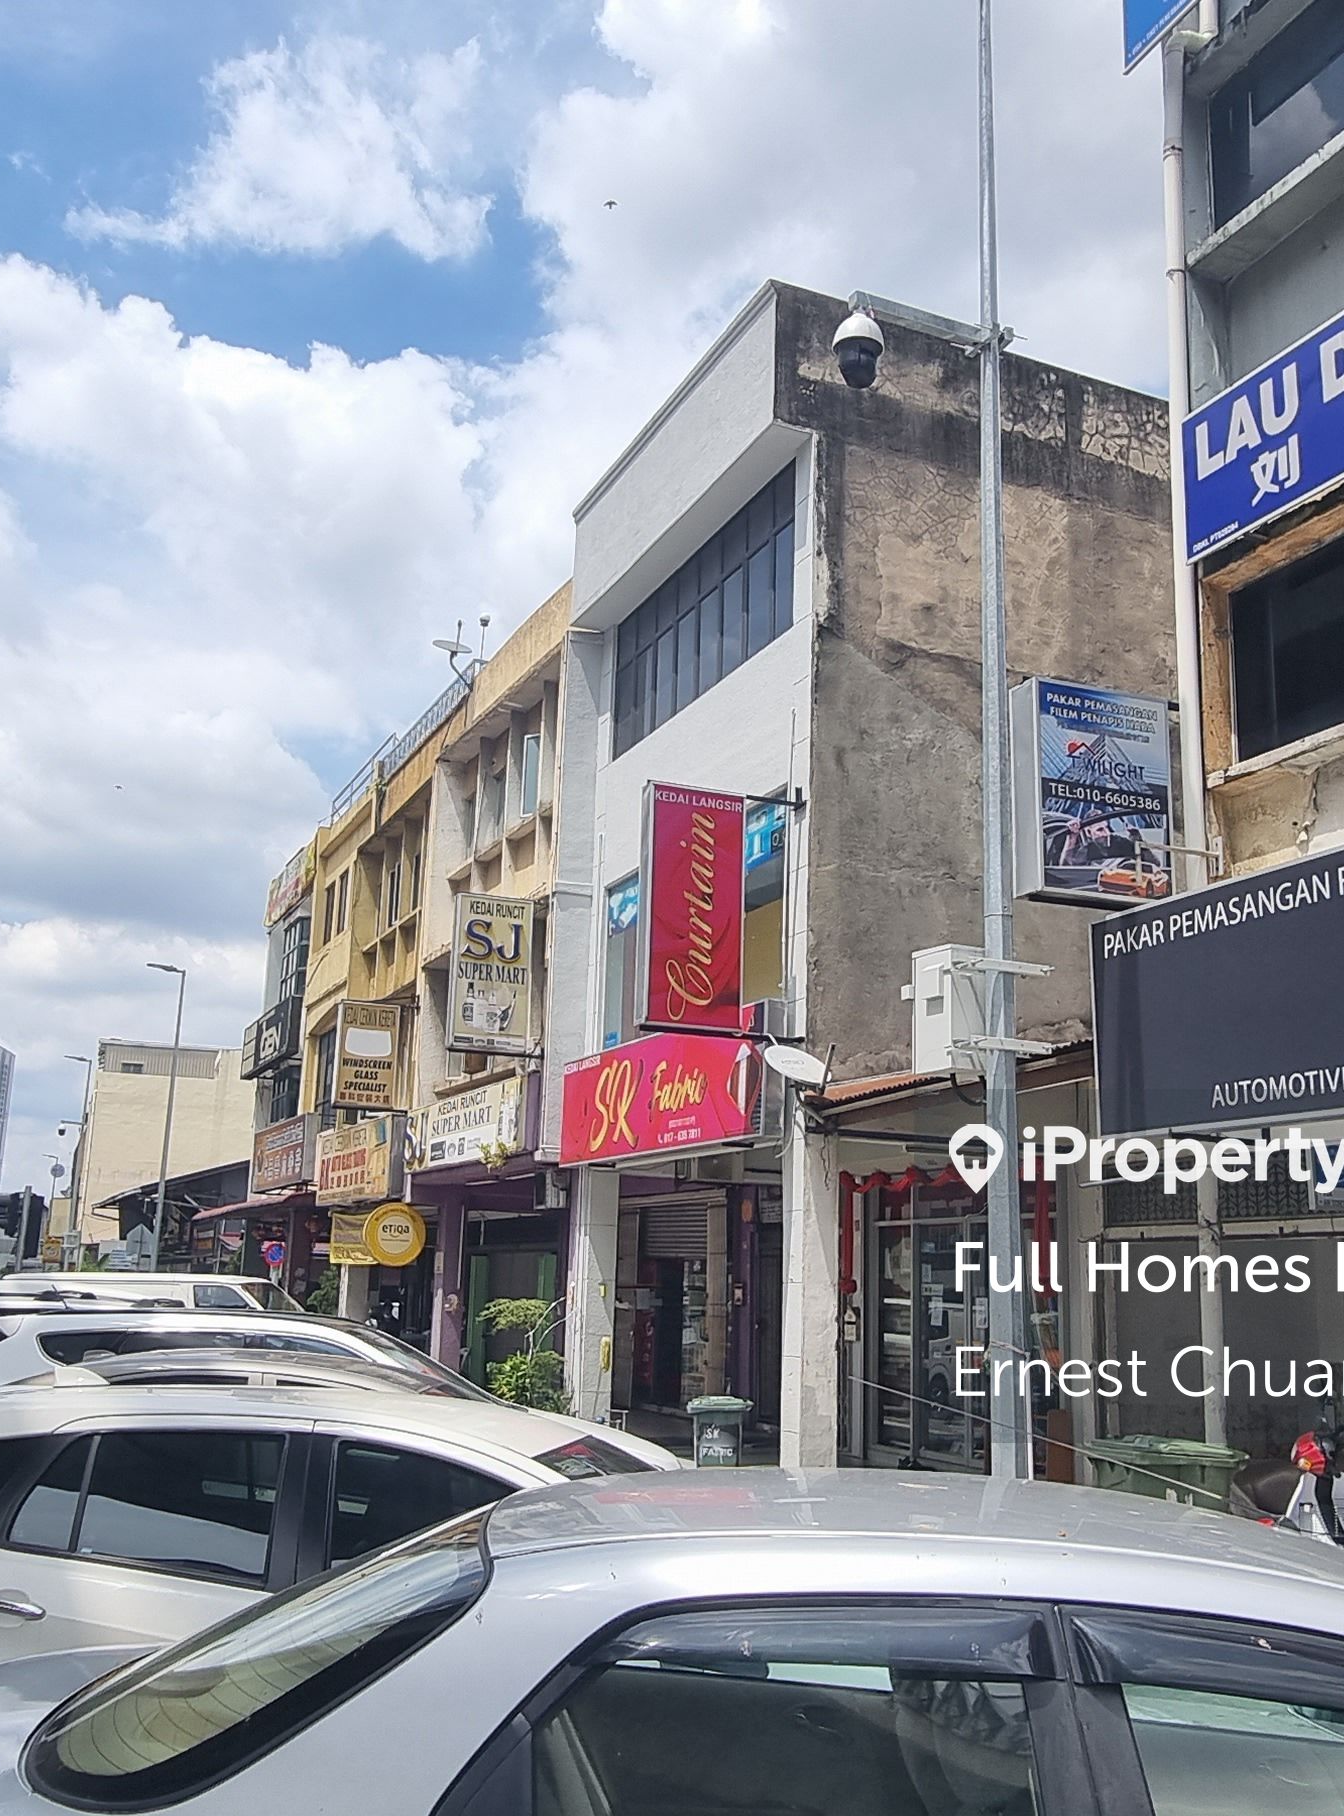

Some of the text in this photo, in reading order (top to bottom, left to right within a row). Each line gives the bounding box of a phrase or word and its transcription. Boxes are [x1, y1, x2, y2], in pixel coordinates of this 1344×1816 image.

[1195, 362, 1299, 481] LAU
[1046, 693, 1158, 722] PAKAR PEMASANGAN
[1050, 706, 1078, 720] FILEM
[1080, 711, 1123, 728] PENAPIS
[1065, 754, 1146, 781] TWILIGHT
[655, 789, 743, 813] KEDAI LANGSIR
[1049, 782, 1161, 811] TEL:010-6605386
[469, 901, 525, 920] KEDAI RUNCIT
[666, 811, 716, 1021] Curtain
[1103, 920, 1165, 959] PAKAR
[1169, 871, 1332, 942] PEMASANGAN
[461, 918, 523, 963] SJ
[457, 962, 527, 986] SUPER MART
[342, 1057, 393, 1070] WINDSCREEN
[353, 1069, 379, 1081] GLASS
[343, 1080, 387, 1093] SPECIALIST
[649, 1060, 707, 1114] Fabric
[437, 1090, 487, 1117] KEDAI RUNCIT
[431, 1105, 492, 1137] SUPER MART
